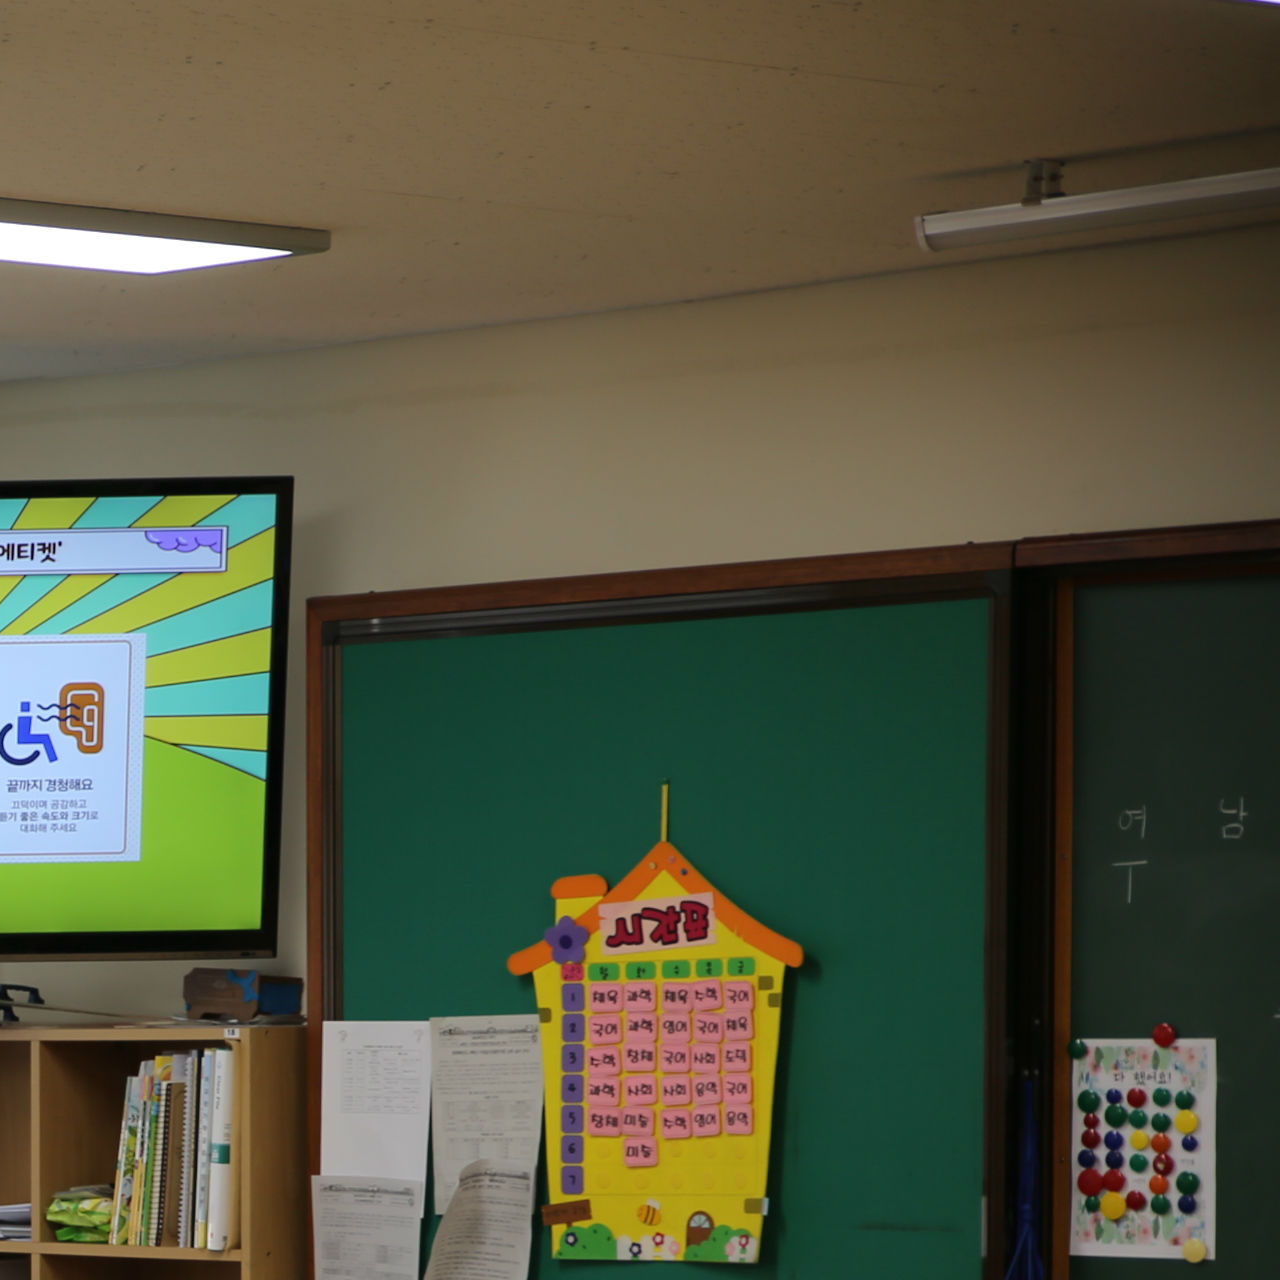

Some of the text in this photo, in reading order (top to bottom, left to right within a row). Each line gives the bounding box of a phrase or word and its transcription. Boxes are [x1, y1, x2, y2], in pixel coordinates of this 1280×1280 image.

[7, 778, 94, 793] 끝까지 경청해요
[1119, 796, 1248, 839] 여 남
[727, 989, 749, 1003] 국어
[592, 1023, 618, 1037] 국어
[663, 1020, 687, 1035] 영어
[697, 1019, 719, 1034] 국어
[569, 1052, 577, 1064] 3
[663, 1050, 686, 1064] 국어
[1113, 1072, 1125, 1083] 다
[695, 1081, 718, 1096] 음악
[726, 1081, 747, 1095] 국어
[568, 1111, 576, 1124] 5
[623, 1113, 649, 1128] 미술
[694, 1113, 716, 1128] 영어
[726, 1111, 749, 1126] 음악
[568, 1143, 651, 1158] 6 미술
